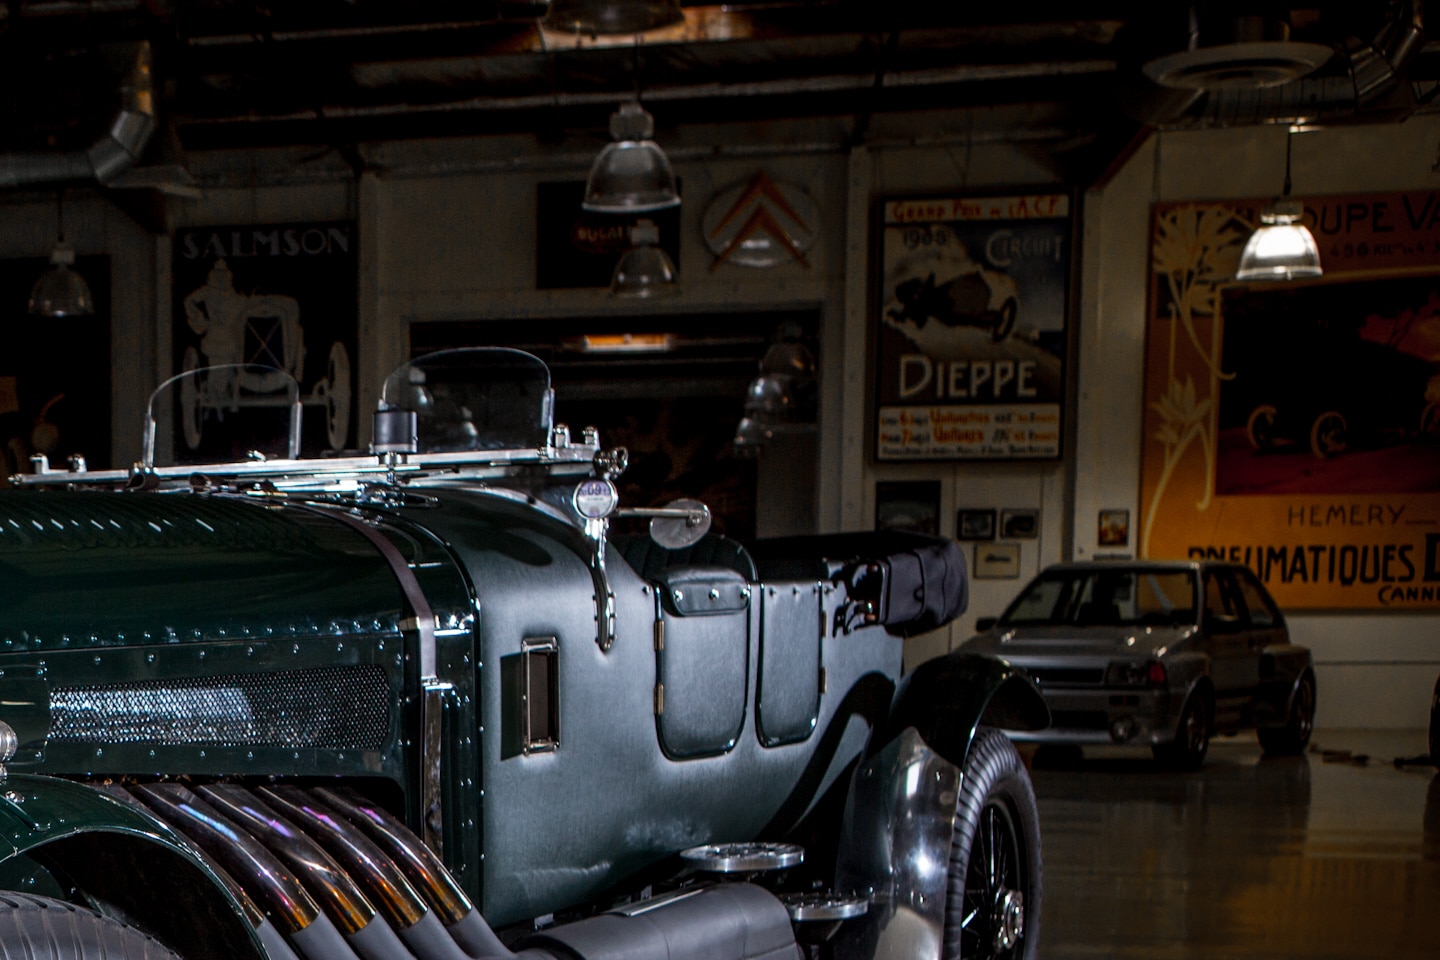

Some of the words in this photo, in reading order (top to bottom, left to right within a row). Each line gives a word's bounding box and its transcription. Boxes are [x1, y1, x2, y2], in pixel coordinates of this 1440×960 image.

[181, 226, 351, 260] SALMSON
[897, 353, 1040, 400] DIEPPE
[1287, 503, 1407, 527] HEMERY
